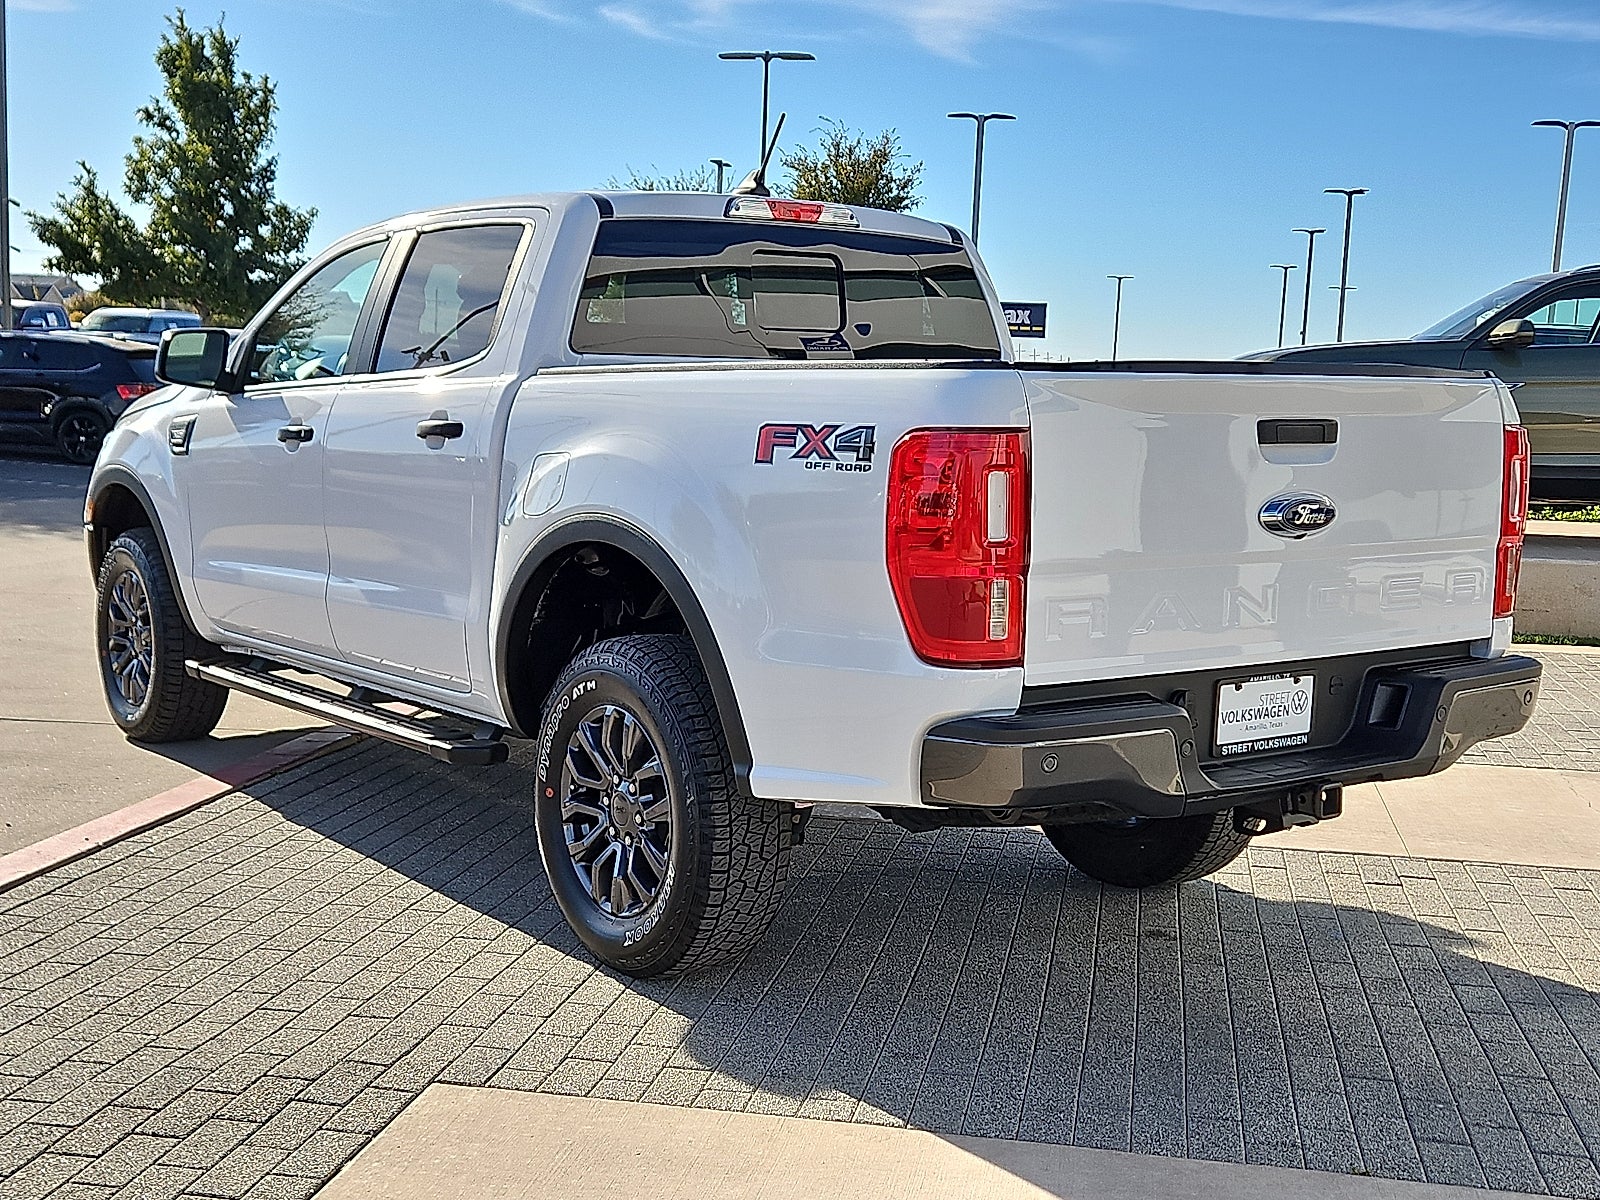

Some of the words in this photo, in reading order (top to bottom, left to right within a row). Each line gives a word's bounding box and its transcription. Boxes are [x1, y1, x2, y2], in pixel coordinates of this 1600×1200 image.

[753, 423, 876, 465] FX4
[804, 461, 831, 471] OFF
[835, 462, 872, 473] ROAD
[1294, 503, 1328, 525] Ford
[1044, 565, 1487, 642] RANGER
[1259, 691, 1292, 706] STREET
[1220, 704, 1291, 724] VOLKSWAGEN
[1269, 721, 1283, 729] Texas
[1221, 742, 1254, 756] STREET
[1253, 735, 1308, 751] VOLKSWAGEN
[623, 860, 676, 947] HANKOOK
